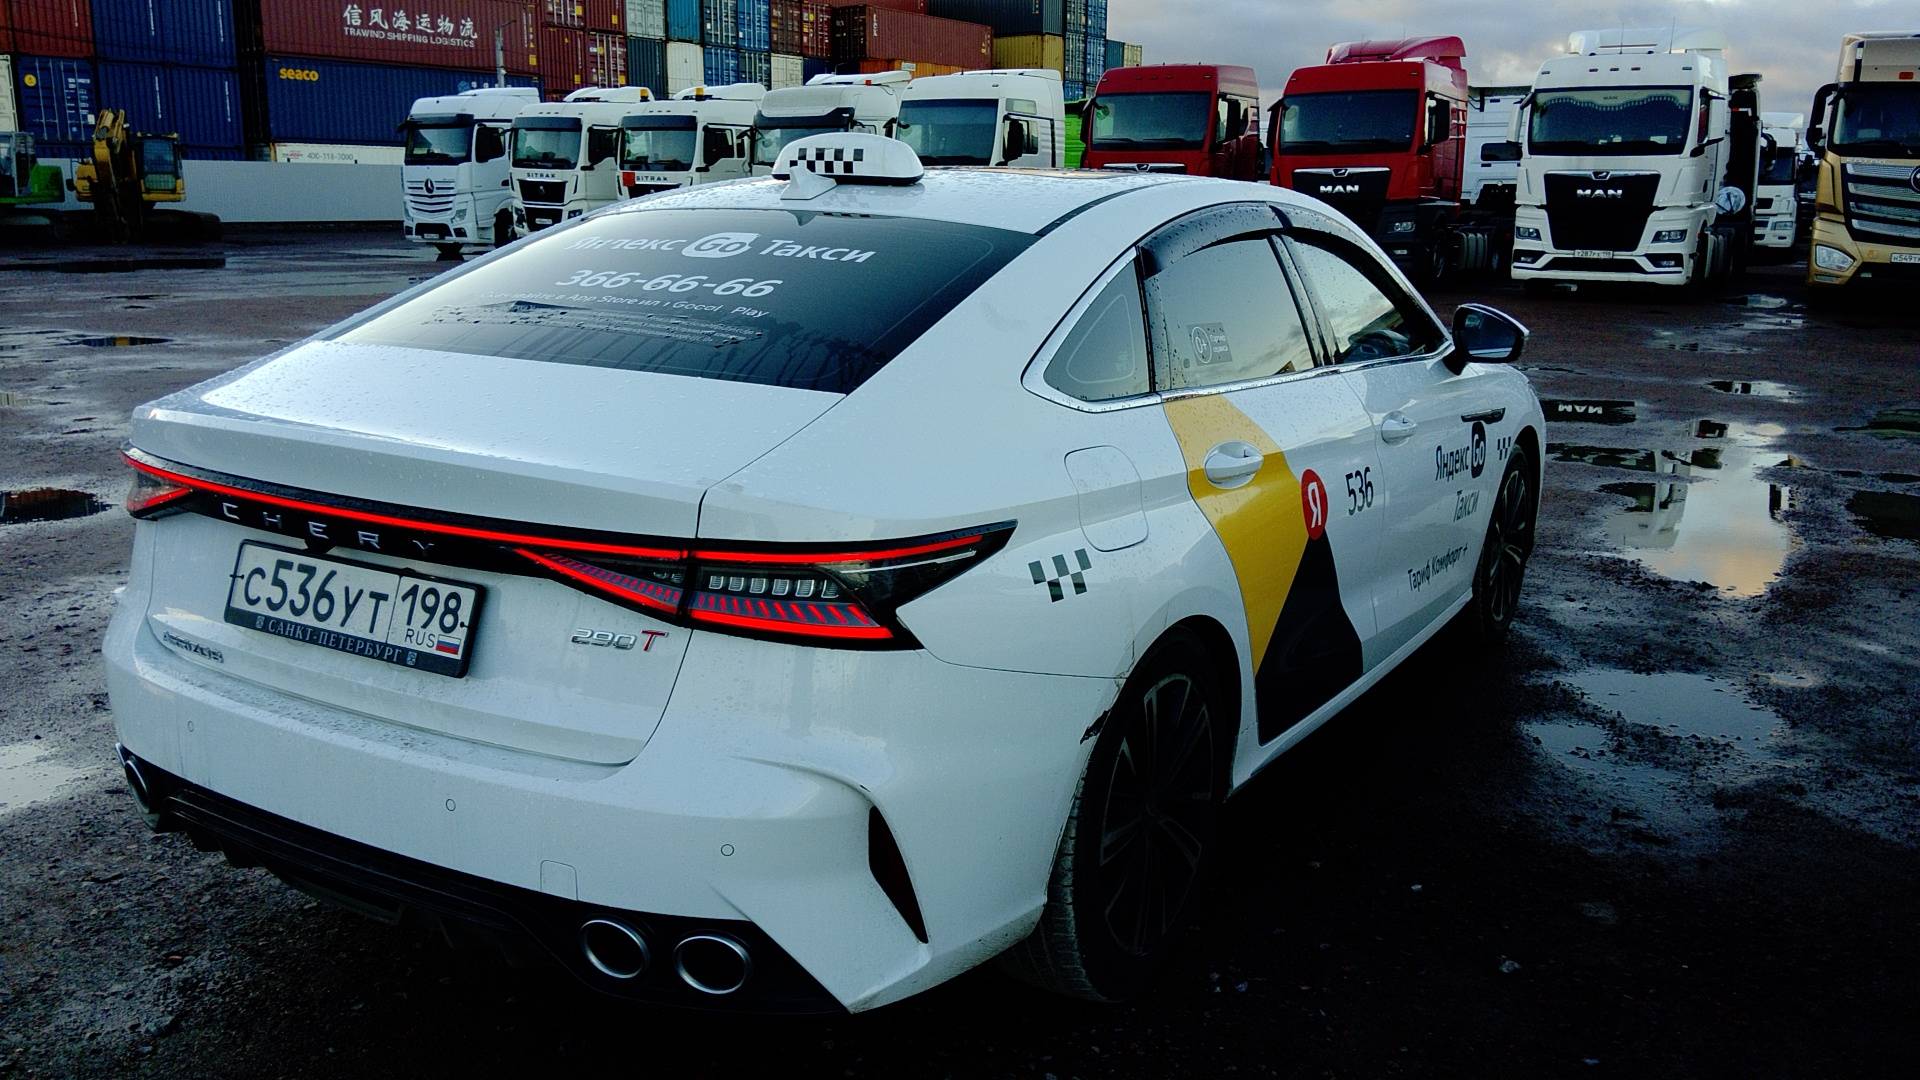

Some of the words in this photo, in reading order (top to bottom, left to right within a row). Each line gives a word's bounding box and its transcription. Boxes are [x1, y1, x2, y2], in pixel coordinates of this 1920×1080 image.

[343, 4, 478, 39] 信风海运物流
[343, 27, 385, 39] TRAWIND
[387, 31, 428, 44] SHIPPING
[430, 37, 475, 48] LOGISTICS
[280, 68, 319, 81] seaco
[1320, 184, 1360, 193] MAN
[1576, 188, 1623, 199] MAN
[694, 237, 748, 252] Go
[760, 240, 876, 262] Такси
[555, 270, 783, 297] 366-66-66
[731, 306, 771, 318] Play
[1435, 445, 1469, 482] Яндекс
[1307, 481, 1322, 529] Я
[1345, 466, 1374, 516] 536
[1453, 490, 1479, 522] Такси
[222, 502, 434, 553] CHERY
[244, 559, 389, 633] С536УТ
[401, 583, 462, 633] 198
[268, 616, 402, 663] САНКТ-ПЕТЕРБУРГ
[404, 628, 436, 648] RUS
